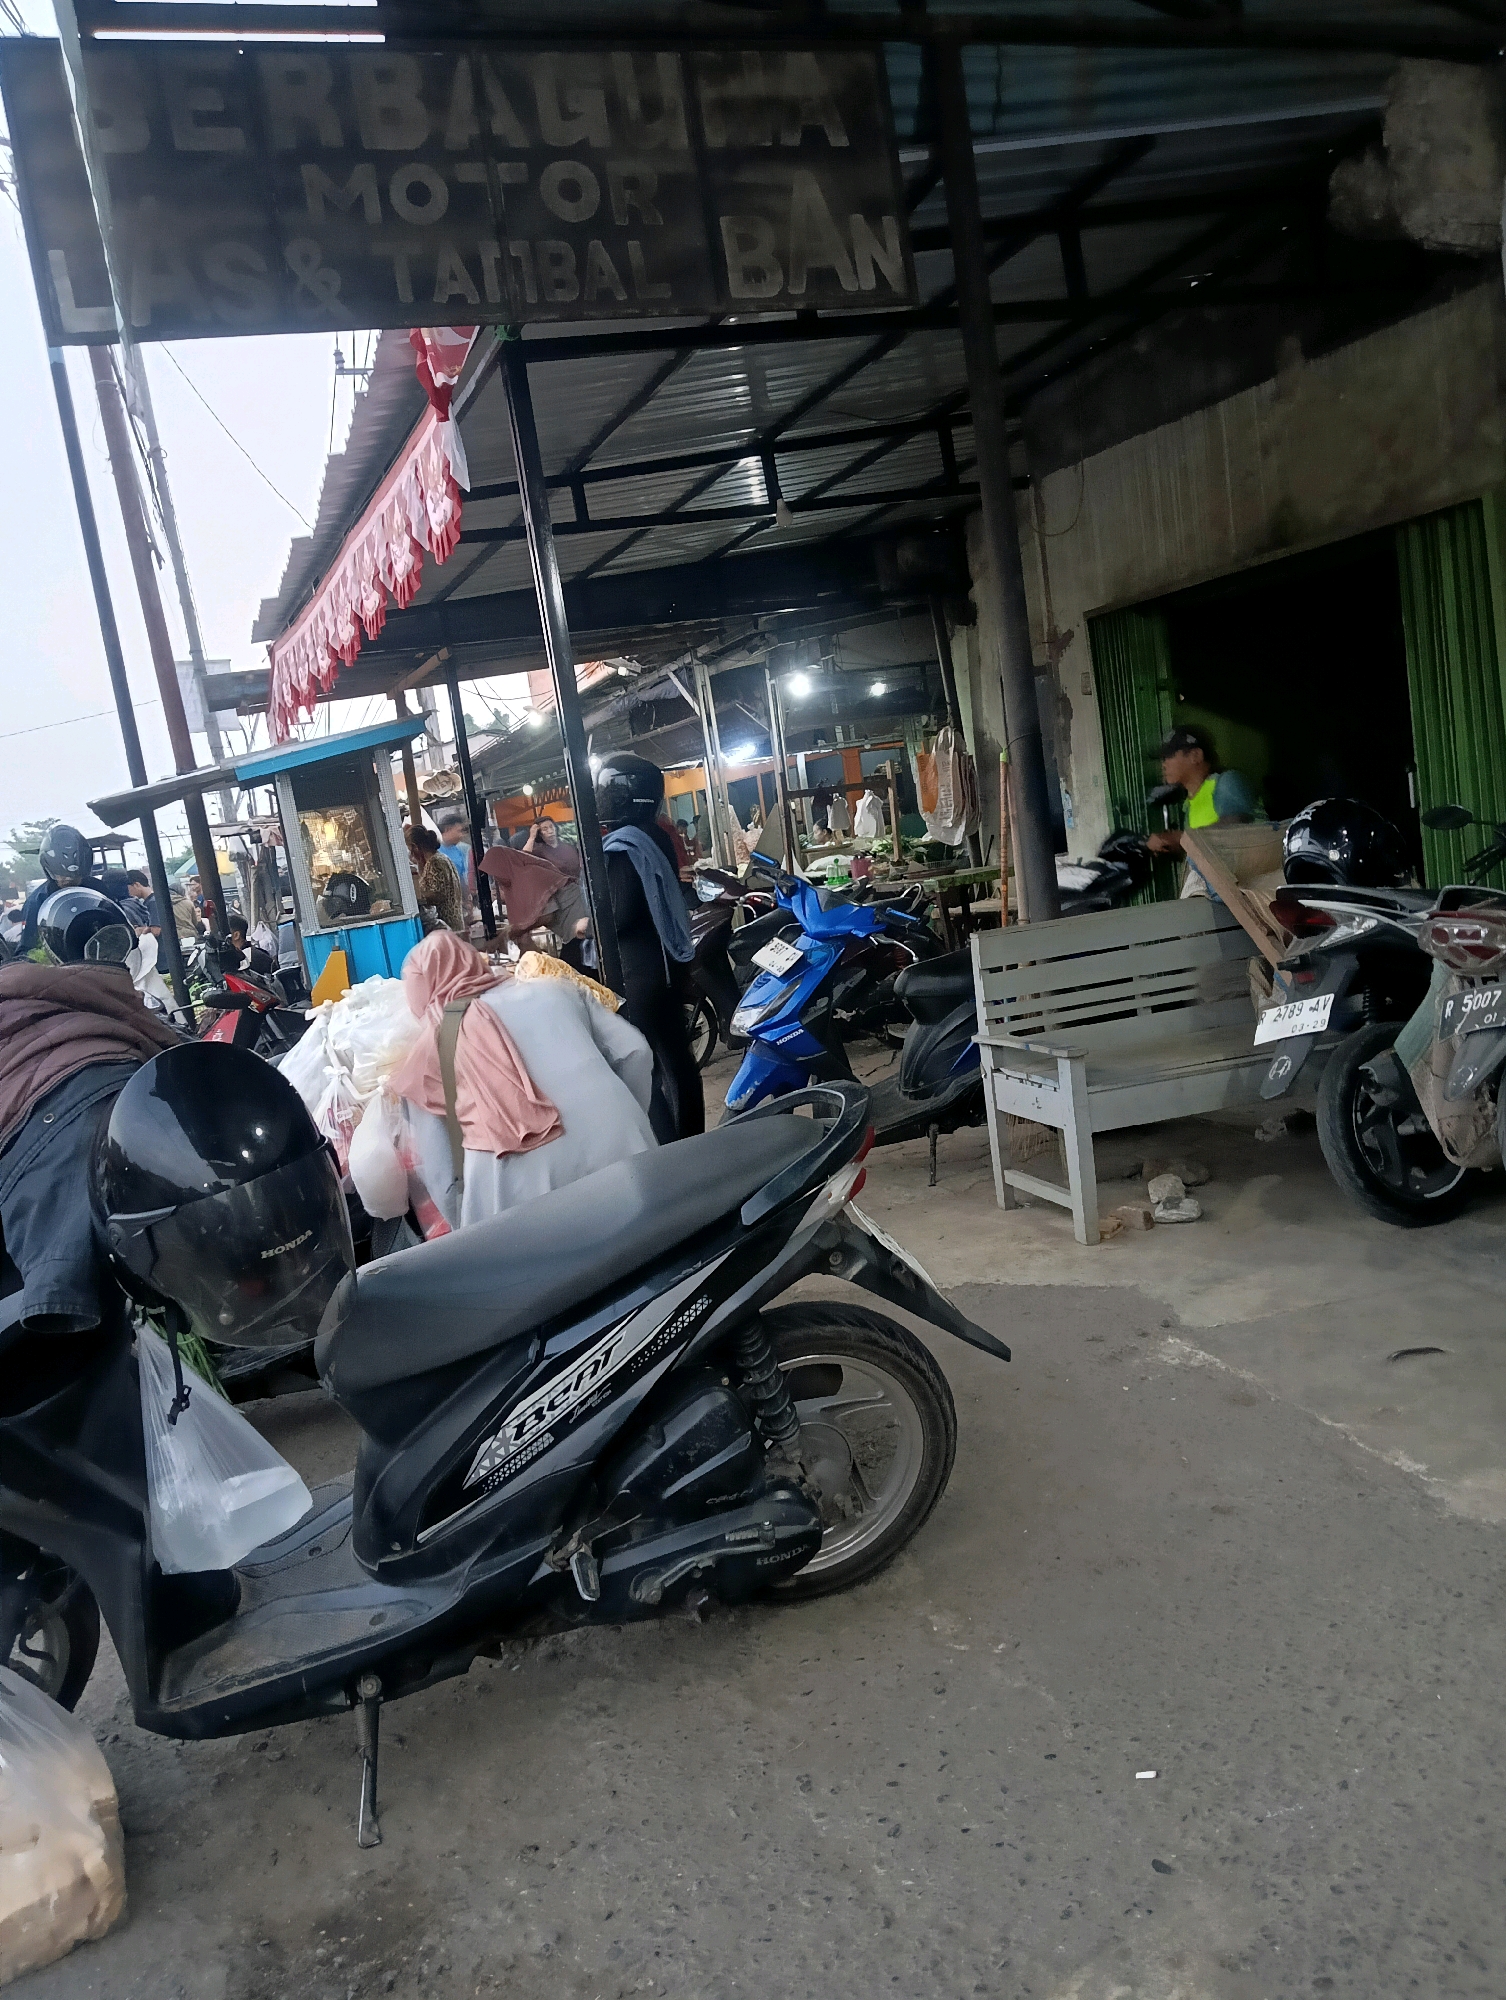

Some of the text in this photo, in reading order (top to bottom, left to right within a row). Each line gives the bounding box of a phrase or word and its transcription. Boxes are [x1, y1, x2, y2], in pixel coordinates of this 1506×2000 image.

[301, 160, 663, 226] MOTOR
[719, 168, 910, 299] BAN
[1273, 1002, 1304, 1023] 2789
[1445, 990, 1502, 1019] R 5007
[776, 1028, 804, 1046] HONDA
[1291, 1018, 1327, 1034] 03-29
[261, 1229, 313, 1259] HONDA
[756, 1543, 811, 1566] HONDA
